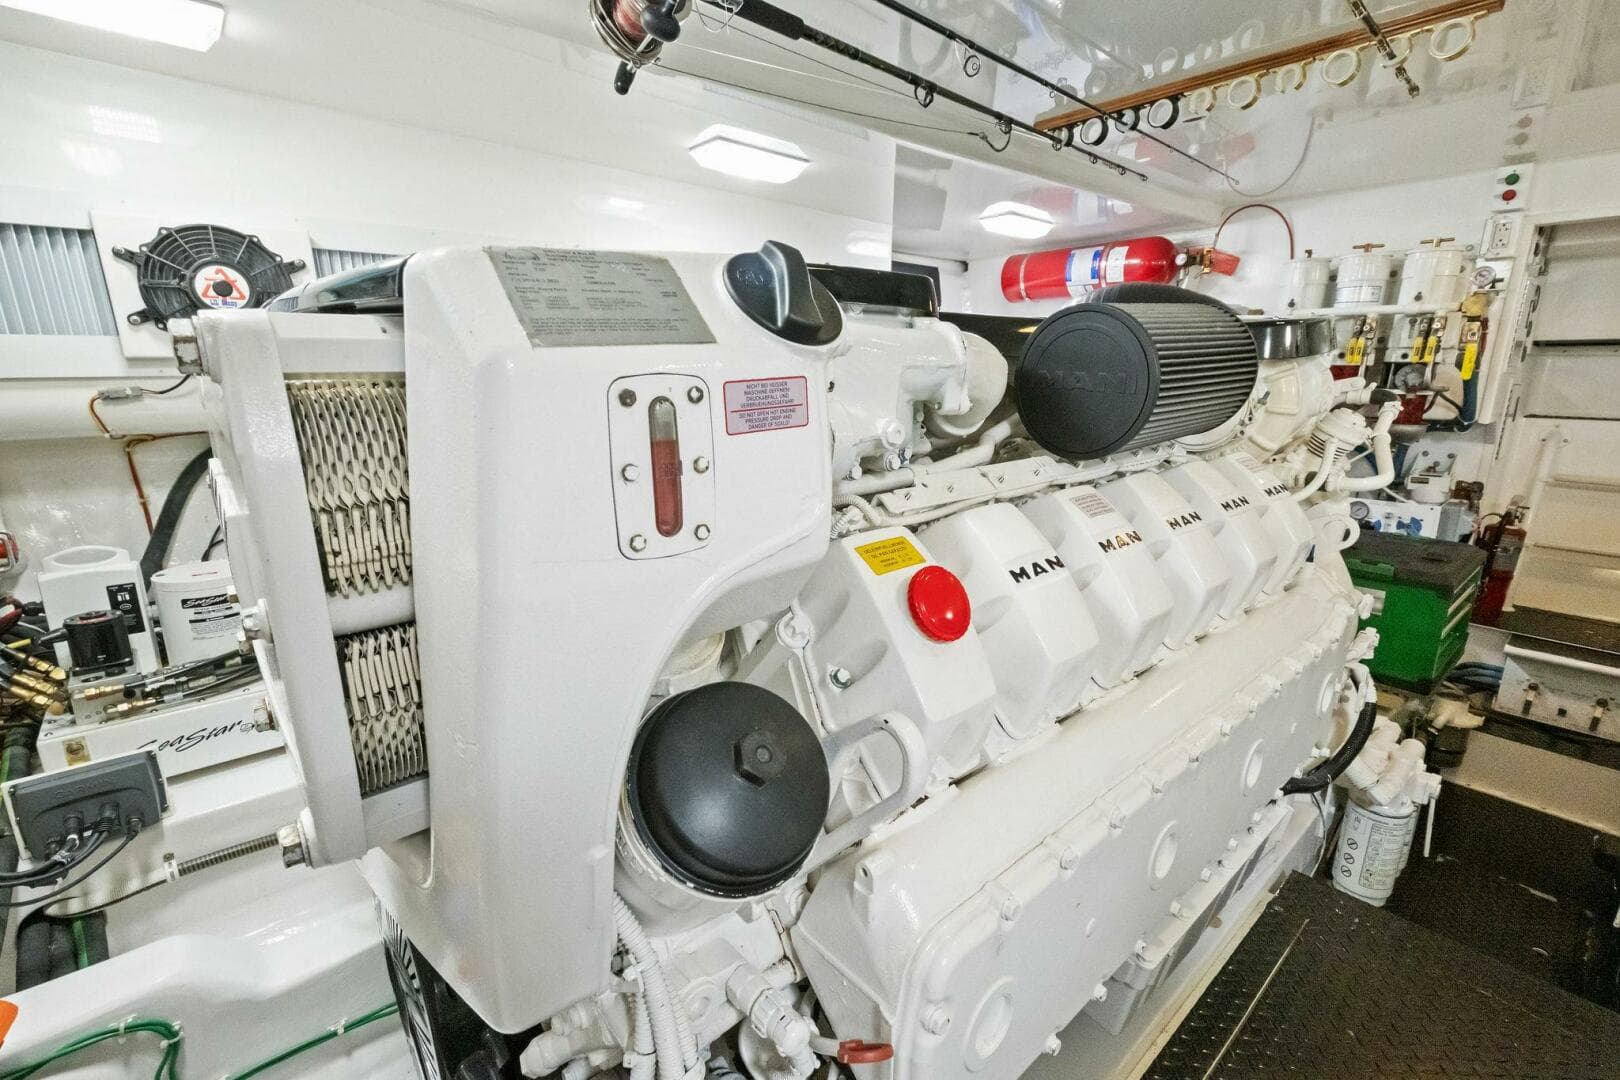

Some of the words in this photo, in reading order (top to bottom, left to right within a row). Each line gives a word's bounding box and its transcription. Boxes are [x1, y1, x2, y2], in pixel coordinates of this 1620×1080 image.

[1036, 369, 1138, 396] MAN
[745, 416, 769, 424] PRESSURE
[770, 408, 779, 416] HOT
[1263, 483, 1289, 498] MAN
[1220, 495, 1251, 513] MAN
[1166, 511, 1203, 530] MAN
[1098, 530, 1143, 554] MAN
[1008, 555, 1065, 584] MAN
